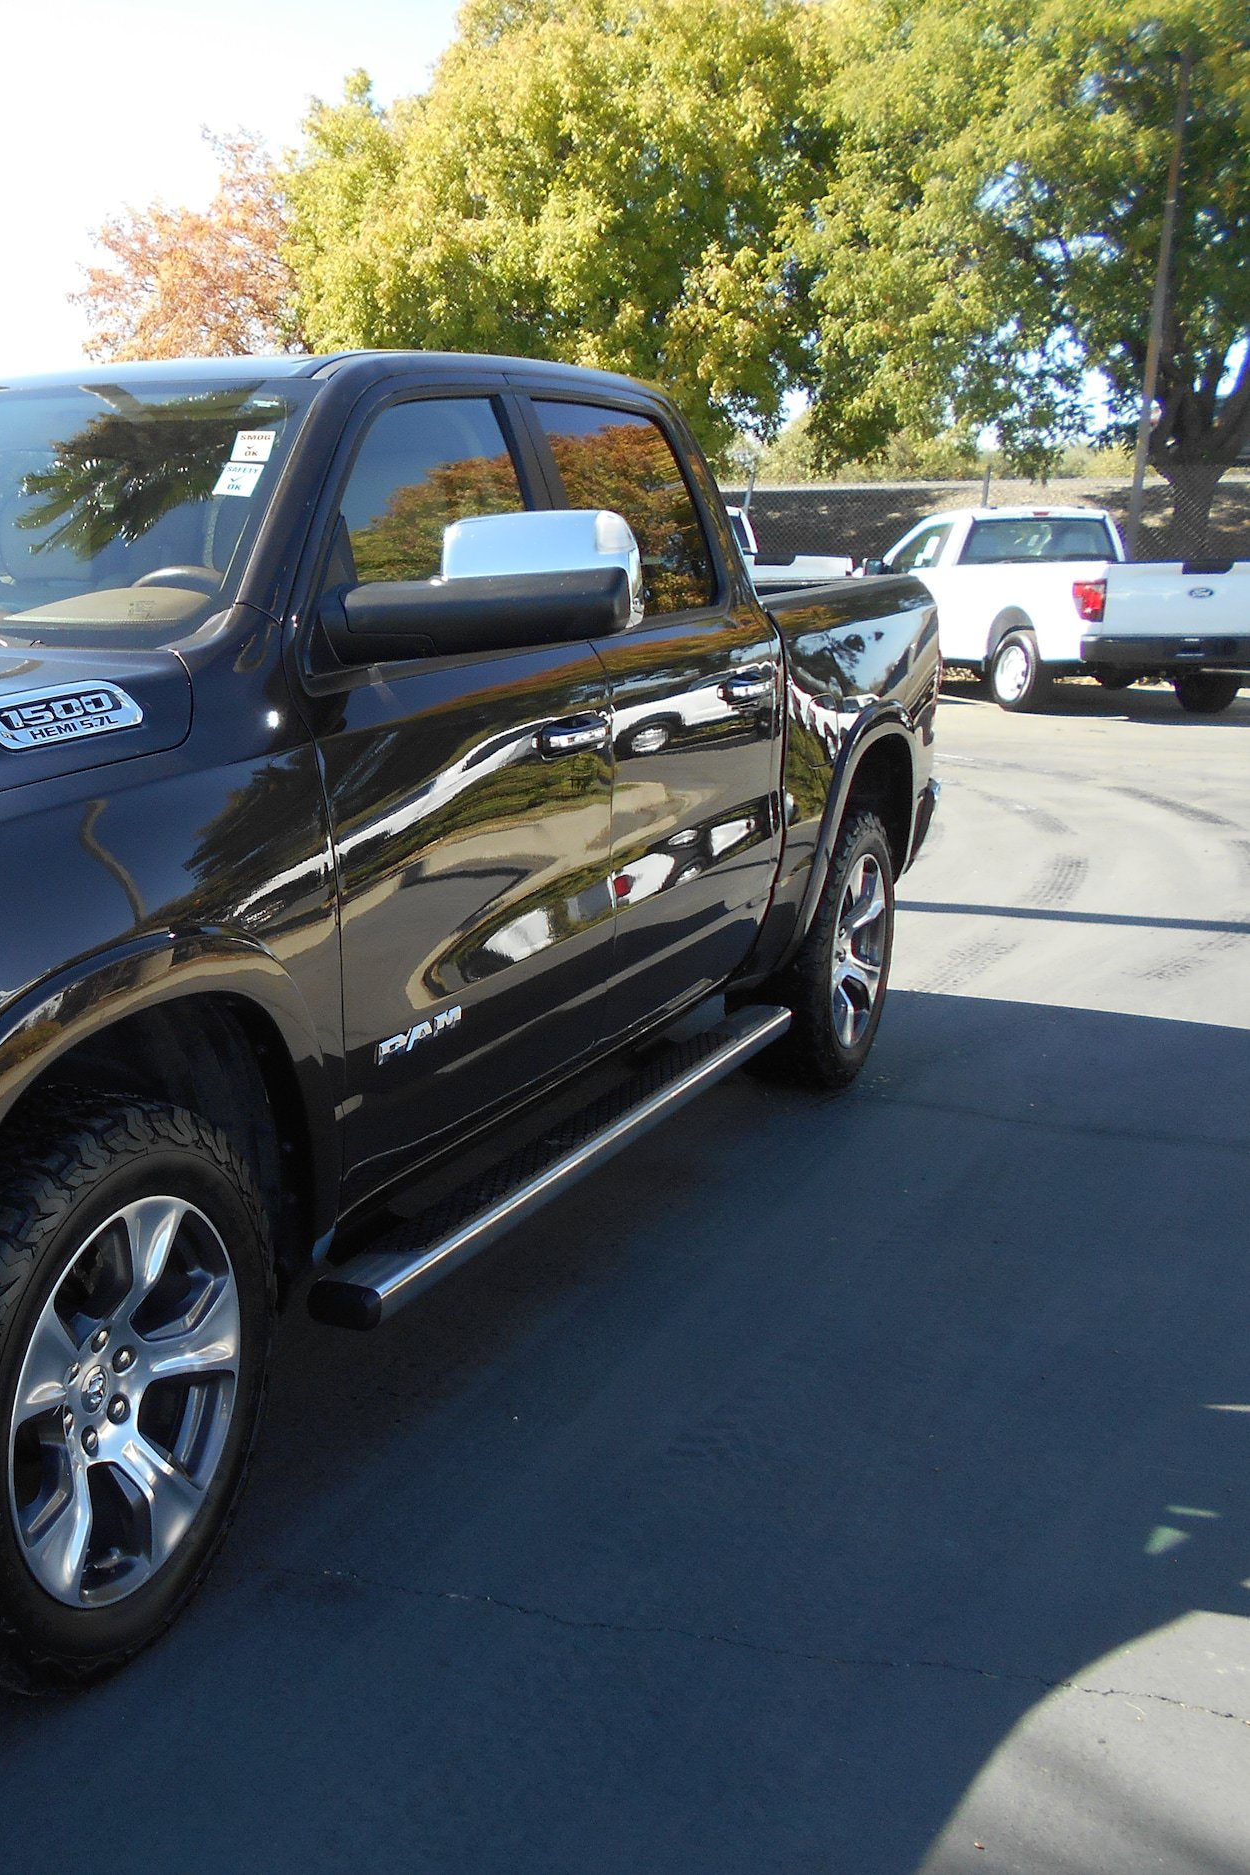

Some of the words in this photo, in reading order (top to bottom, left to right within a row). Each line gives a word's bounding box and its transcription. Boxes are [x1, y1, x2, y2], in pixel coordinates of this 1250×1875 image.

[226, 466, 260, 474] SAFETY
[1, 692, 114, 729] 1500
[30, 721, 78, 742] HEMI
[79, 714, 119, 731] 5.7L
[375, 1005, 462, 1066] RAM
